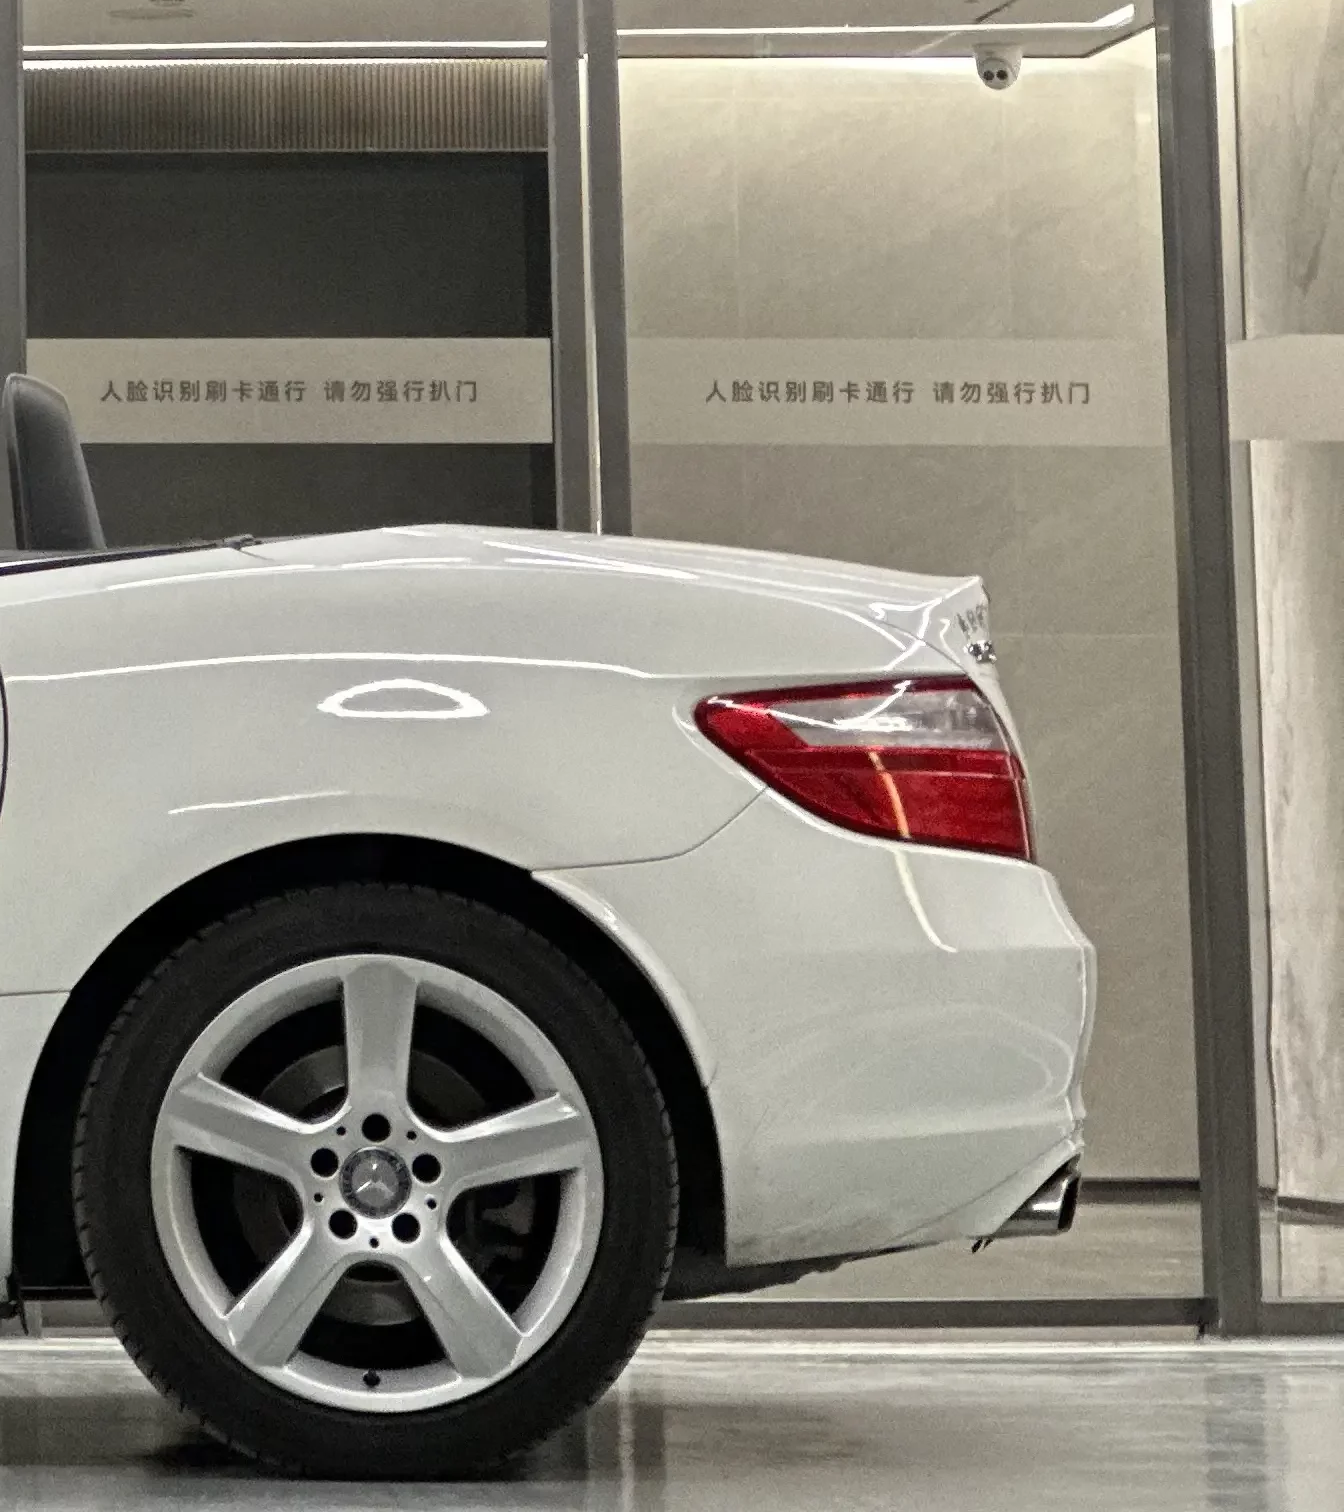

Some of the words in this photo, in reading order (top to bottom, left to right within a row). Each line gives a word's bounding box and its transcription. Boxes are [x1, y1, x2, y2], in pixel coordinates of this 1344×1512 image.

[99, 379, 307, 403] 人脸识别刷卡通行
[323, 379, 479, 404] 请勿强行扒门
[705, 379, 916, 404] 人脸识别刷卡通行
[932, 379, 1091, 405] 请勿强行扒门
